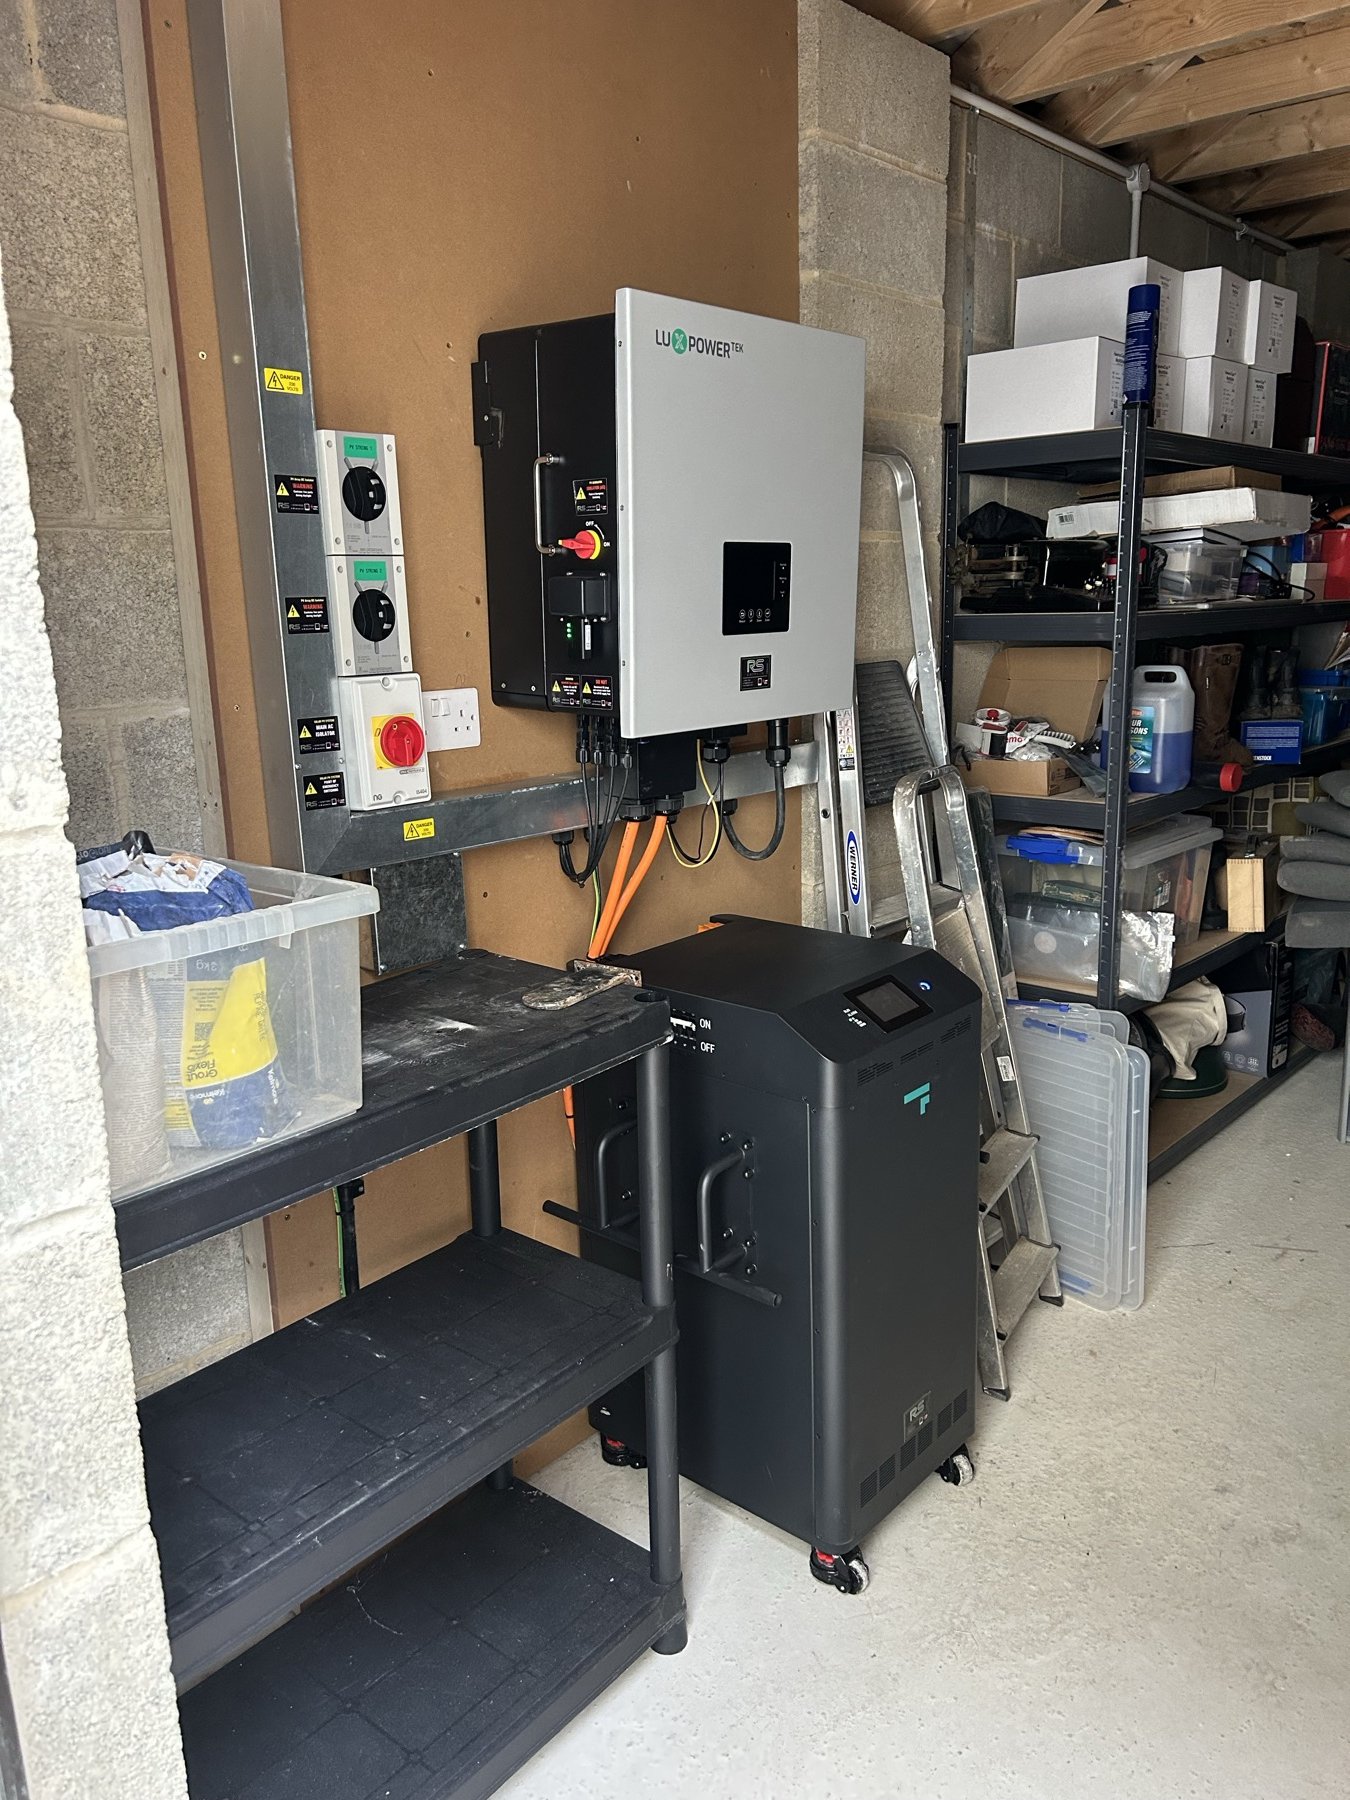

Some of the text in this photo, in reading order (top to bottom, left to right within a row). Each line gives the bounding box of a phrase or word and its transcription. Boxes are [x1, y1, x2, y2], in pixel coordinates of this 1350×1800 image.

[279, 373, 301, 381] DANGER
[291, 482, 314, 490] WARNING
[746, 658, 765, 673] RS
[315, 730, 336, 738] ISOLATOR
[849, 846, 858, 891] WERNER
[699, 1018, 712, 1030] ON
[700, 1041, 716, 1053] OFF
[186, 1068, 218, 1082] Grout
[909, 1400, 925, 1422] RS
